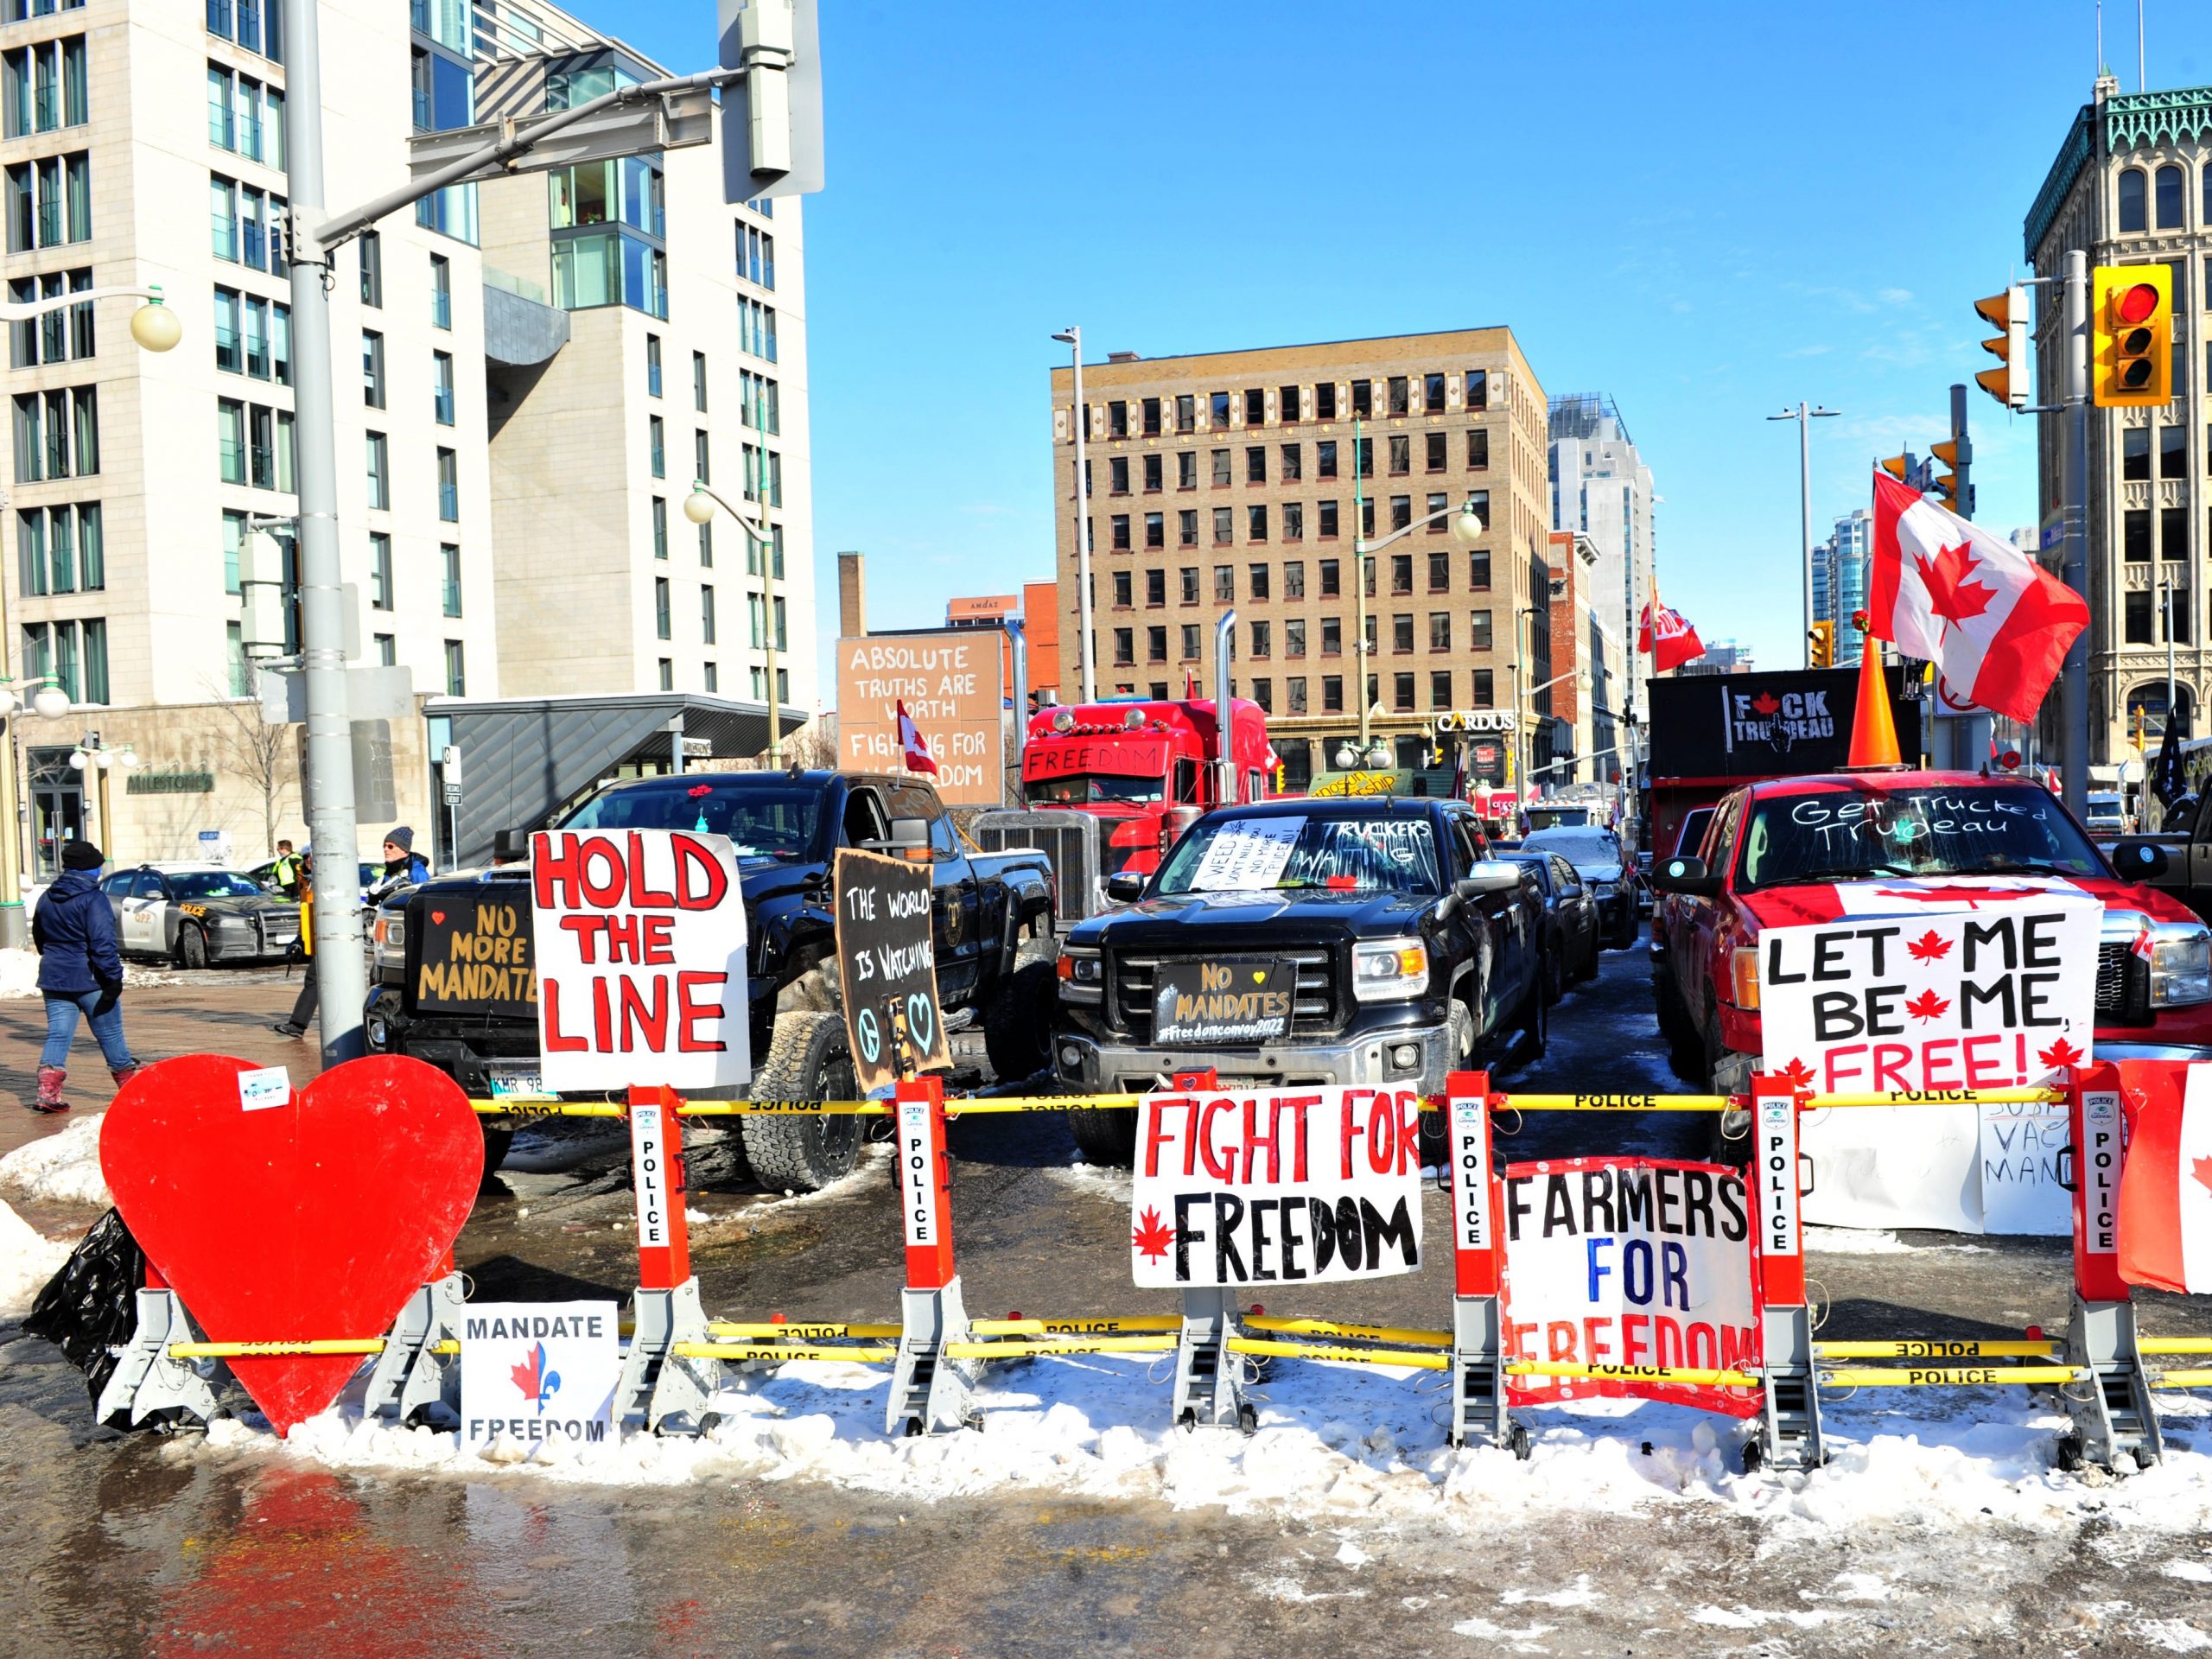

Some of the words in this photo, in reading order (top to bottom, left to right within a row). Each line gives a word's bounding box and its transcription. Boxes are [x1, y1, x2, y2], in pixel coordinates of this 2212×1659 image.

[850, 645, 969, 671] ABSOLUTE
[855, 677, 927, 698] TRUTHS
[938, 673, 976, 696] ARE
[1437, 712, 1516, 732] CARDUS
[953, 731, 986, 756] FOR
[1028, 747, 1157, 775] FREEDOM
[1792, 799, 1884, 825] Get
[1909, 796, 2048, 820] Trucked
[1249, 827, 1262, 841] YOU
[1322, 820, 1430, 841] TRUCKERS
[1815, 817, 2007, 850] Trudeau
[1204, 841, 1237, 878] WEED
[1249, 860, 1264, 874] NO
[1258, 833, 1277, 856] MORE
[1298, 848, 1415, 875] WAITING
[532, 830, 728, 911] HOLD
[179, 904, 207, 918] POLICE
[847, 886, 876, 920] THE
[887, 888, 930, 919] WORLD
[477, 904, 517, 938] NO
[451, 931, 527, 964] MORE
[560, 915, 677, 965] THE
[1768, 926, 1901, 986] LET
[1962, 913, 2066, 973] ME
[855, 950, 874, 982] IS
[877, 939, 933, 982] WATCHING
[1202, 962, 1233, 992] NO
[543, 970, 729, 1054] LINE
[1174, 991, 1291, 1023] MANDATES
[1812, 984, 1907, 1042] BE
[1824, 1033, 2028, 1094] FREE!
[493, 1077, 519, 1093] KMR
[1575, 1094, 1656, 1108] POLICE
[1890, 1090, 1978, 1102] POLICE
[1144, 1094, 1323, 1185] FIGHT
[1340, 1089, 1421, 1180] FOR
[643, 1141, 659, 1242] POLICE
[911, 1138, 927, 1240] POLICE
[1462, 1135, 1480, 1244] POLICE
[1507, 1167, 1748, 1241] FARMERS
[1770, 1136, 1787, 1249] POLICE
[2094, 1132, 2113, 1248] POLICE
[1174, 1192, 1419, 1284] FREEDOM
[1586, 1237, 1690, 1312] FOR
[467, 1316, 603, 1339] MANDATE
[1896, 1342, 1980, 1357] POLICE
[1910, 1370, 1998, 1384] POLICE
